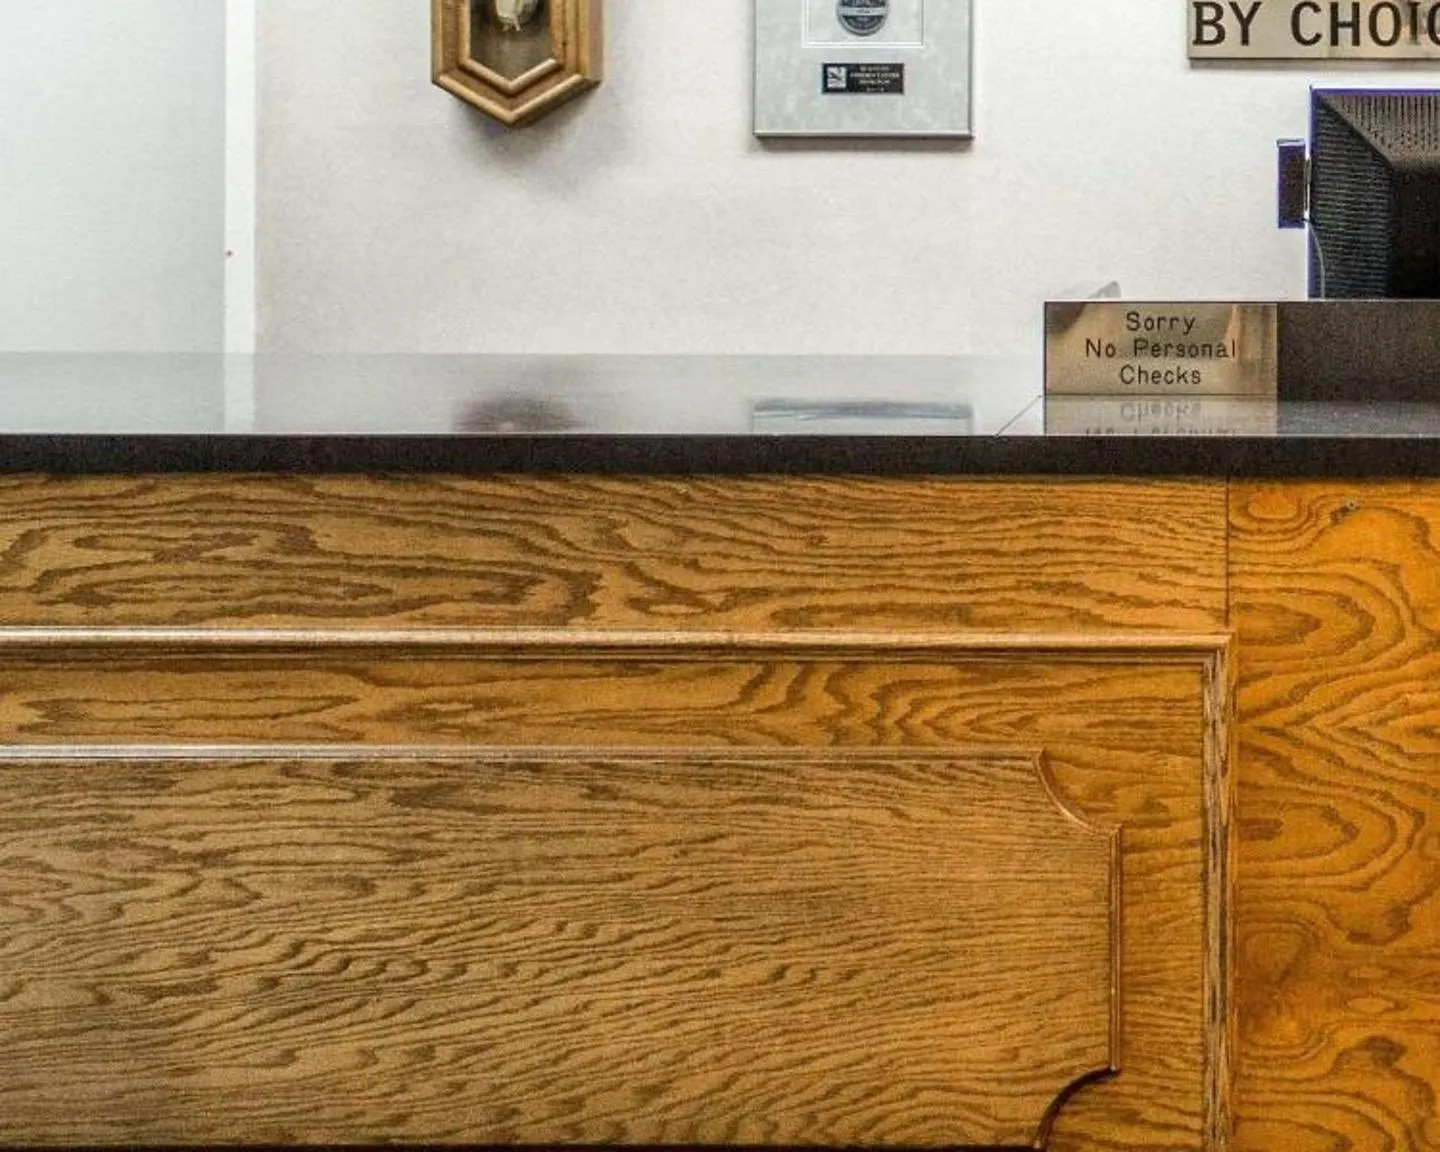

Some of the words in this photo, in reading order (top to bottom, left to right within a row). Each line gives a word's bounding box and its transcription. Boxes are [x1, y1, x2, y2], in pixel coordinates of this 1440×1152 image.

[1191, 0, 1262, 47] BY
[1126, 311, 1196, 334] Sorry
[1085, 337, 1117, 358] No
[1133, 337, 1237, 359] Personal
[1118, 363, 1203, 385] Checks
